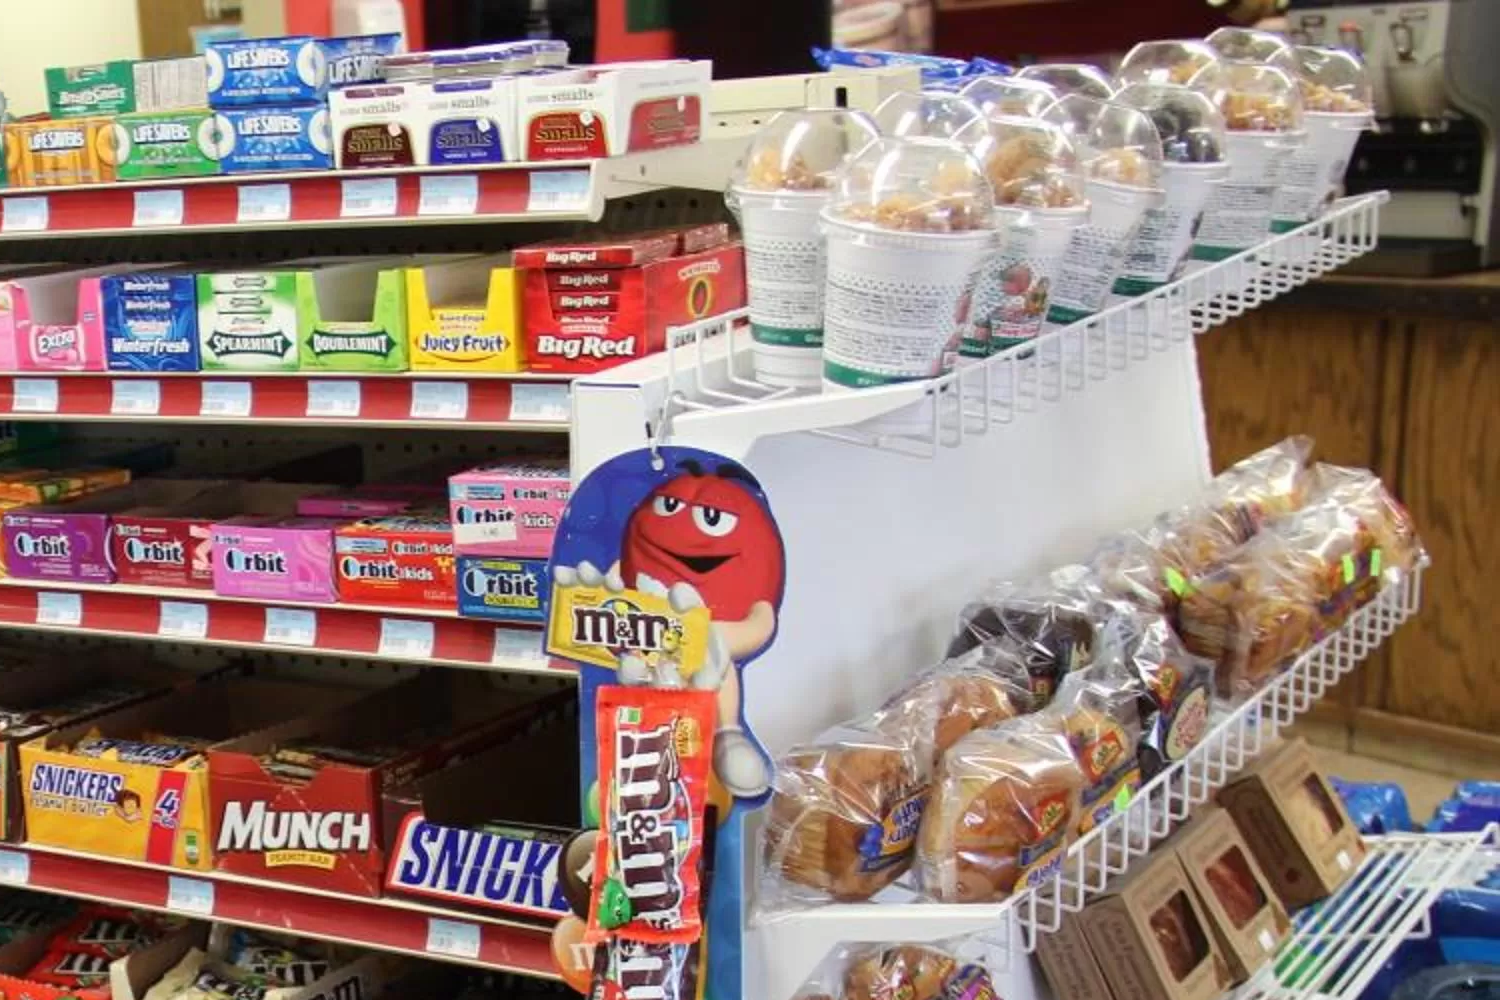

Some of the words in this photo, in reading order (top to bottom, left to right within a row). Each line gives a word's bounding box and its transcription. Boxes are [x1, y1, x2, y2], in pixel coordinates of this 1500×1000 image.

[112, 336, 190, 356] Winterfresh
[213, 331, 283, 352] SPEARMINT
[313, 334, 388, 352] DOUBLEMINT
[420, 334, 460, 352] Juicy
[463, 335, 505, 352] Fruit
[537, 334, 581, 358] Big
[582, 334, 636, 357] Red
[14, 531, 72, 559] Orbit
[124, 537, 185, 564] Orbit
[225, 547, 288, 576] Orbit
[340, 556, 399, 581] Orbit
[463, 568, 537, 598] Orbit
[31, 763, 124, 804] SNICKERS
[157, 789, 180, 813] 4
[217, 800, 371, 852] MUNCH
